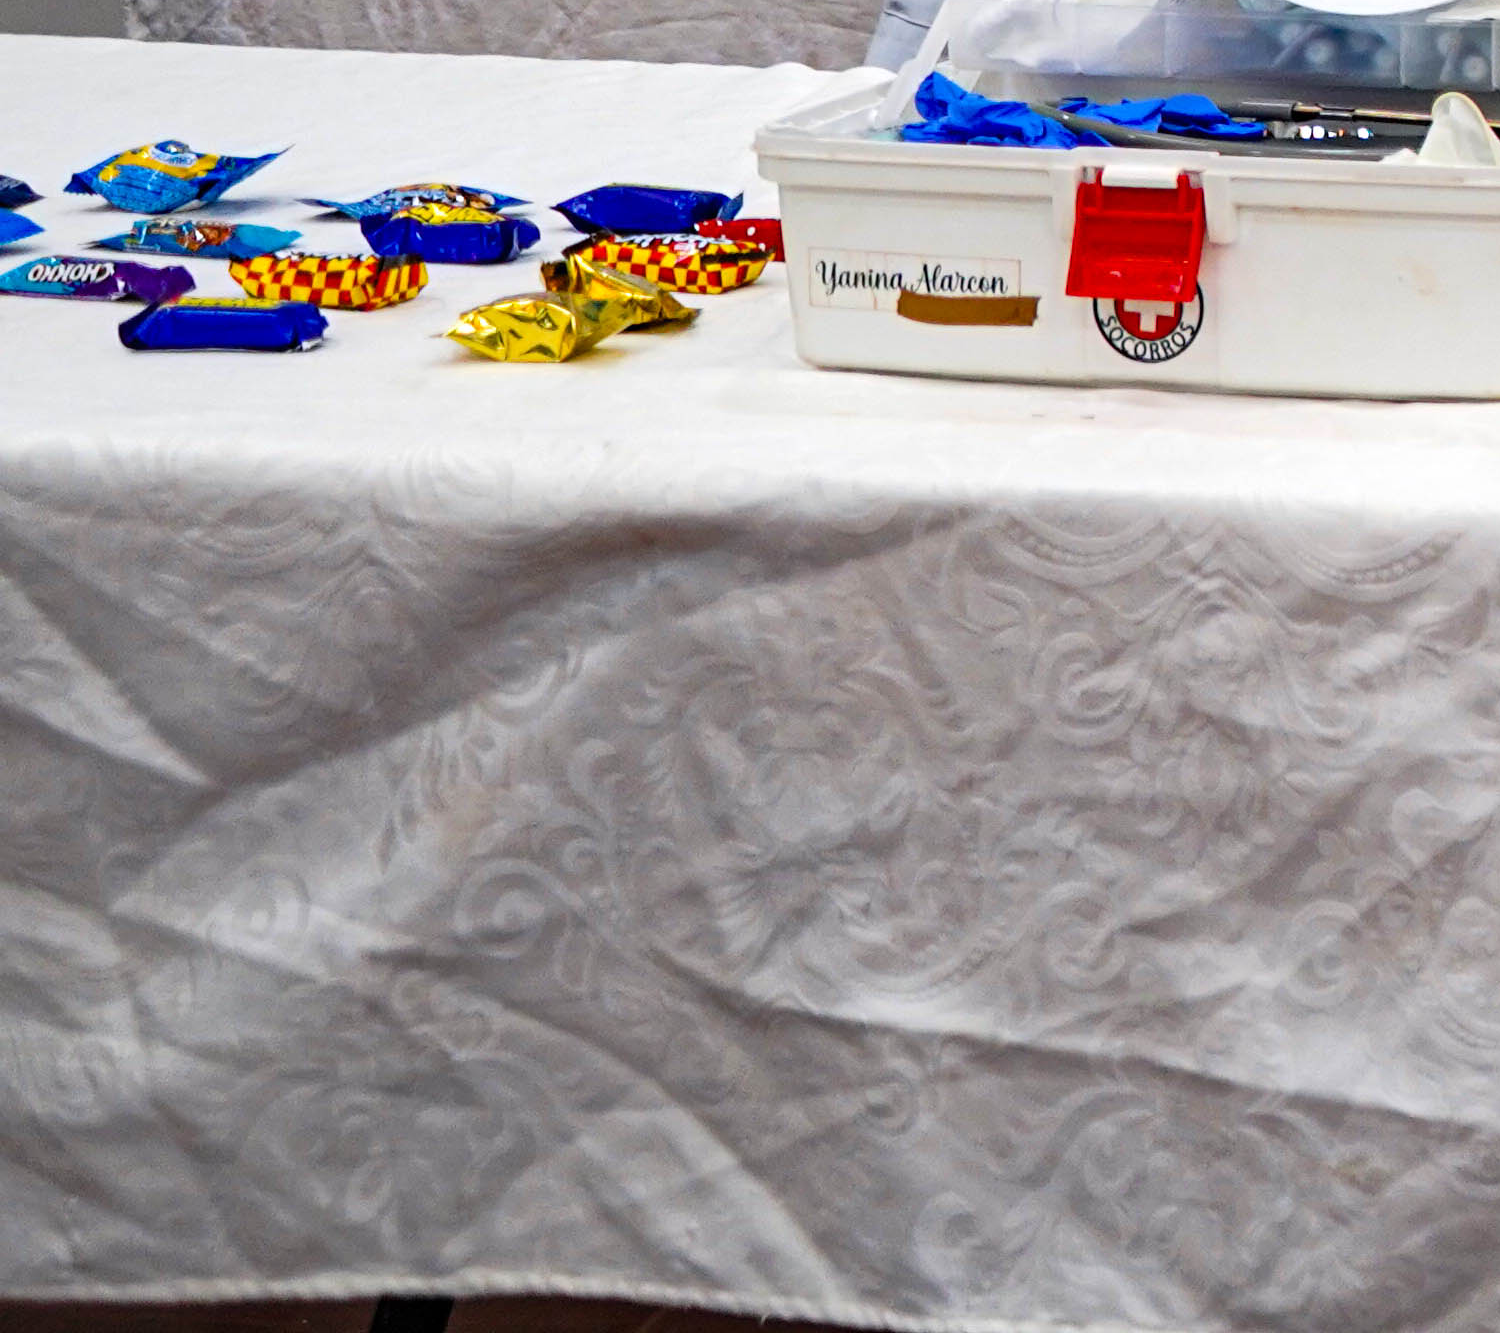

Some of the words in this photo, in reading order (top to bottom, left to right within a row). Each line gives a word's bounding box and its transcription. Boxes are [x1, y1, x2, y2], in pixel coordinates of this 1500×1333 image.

[27, 261, 116, 284] CHOKKO
[815, 260, 903, 296] Yanina
[910, 263, 1009, 295] Alarcon
[1101, 314, 1196, 361] SOCORROS
